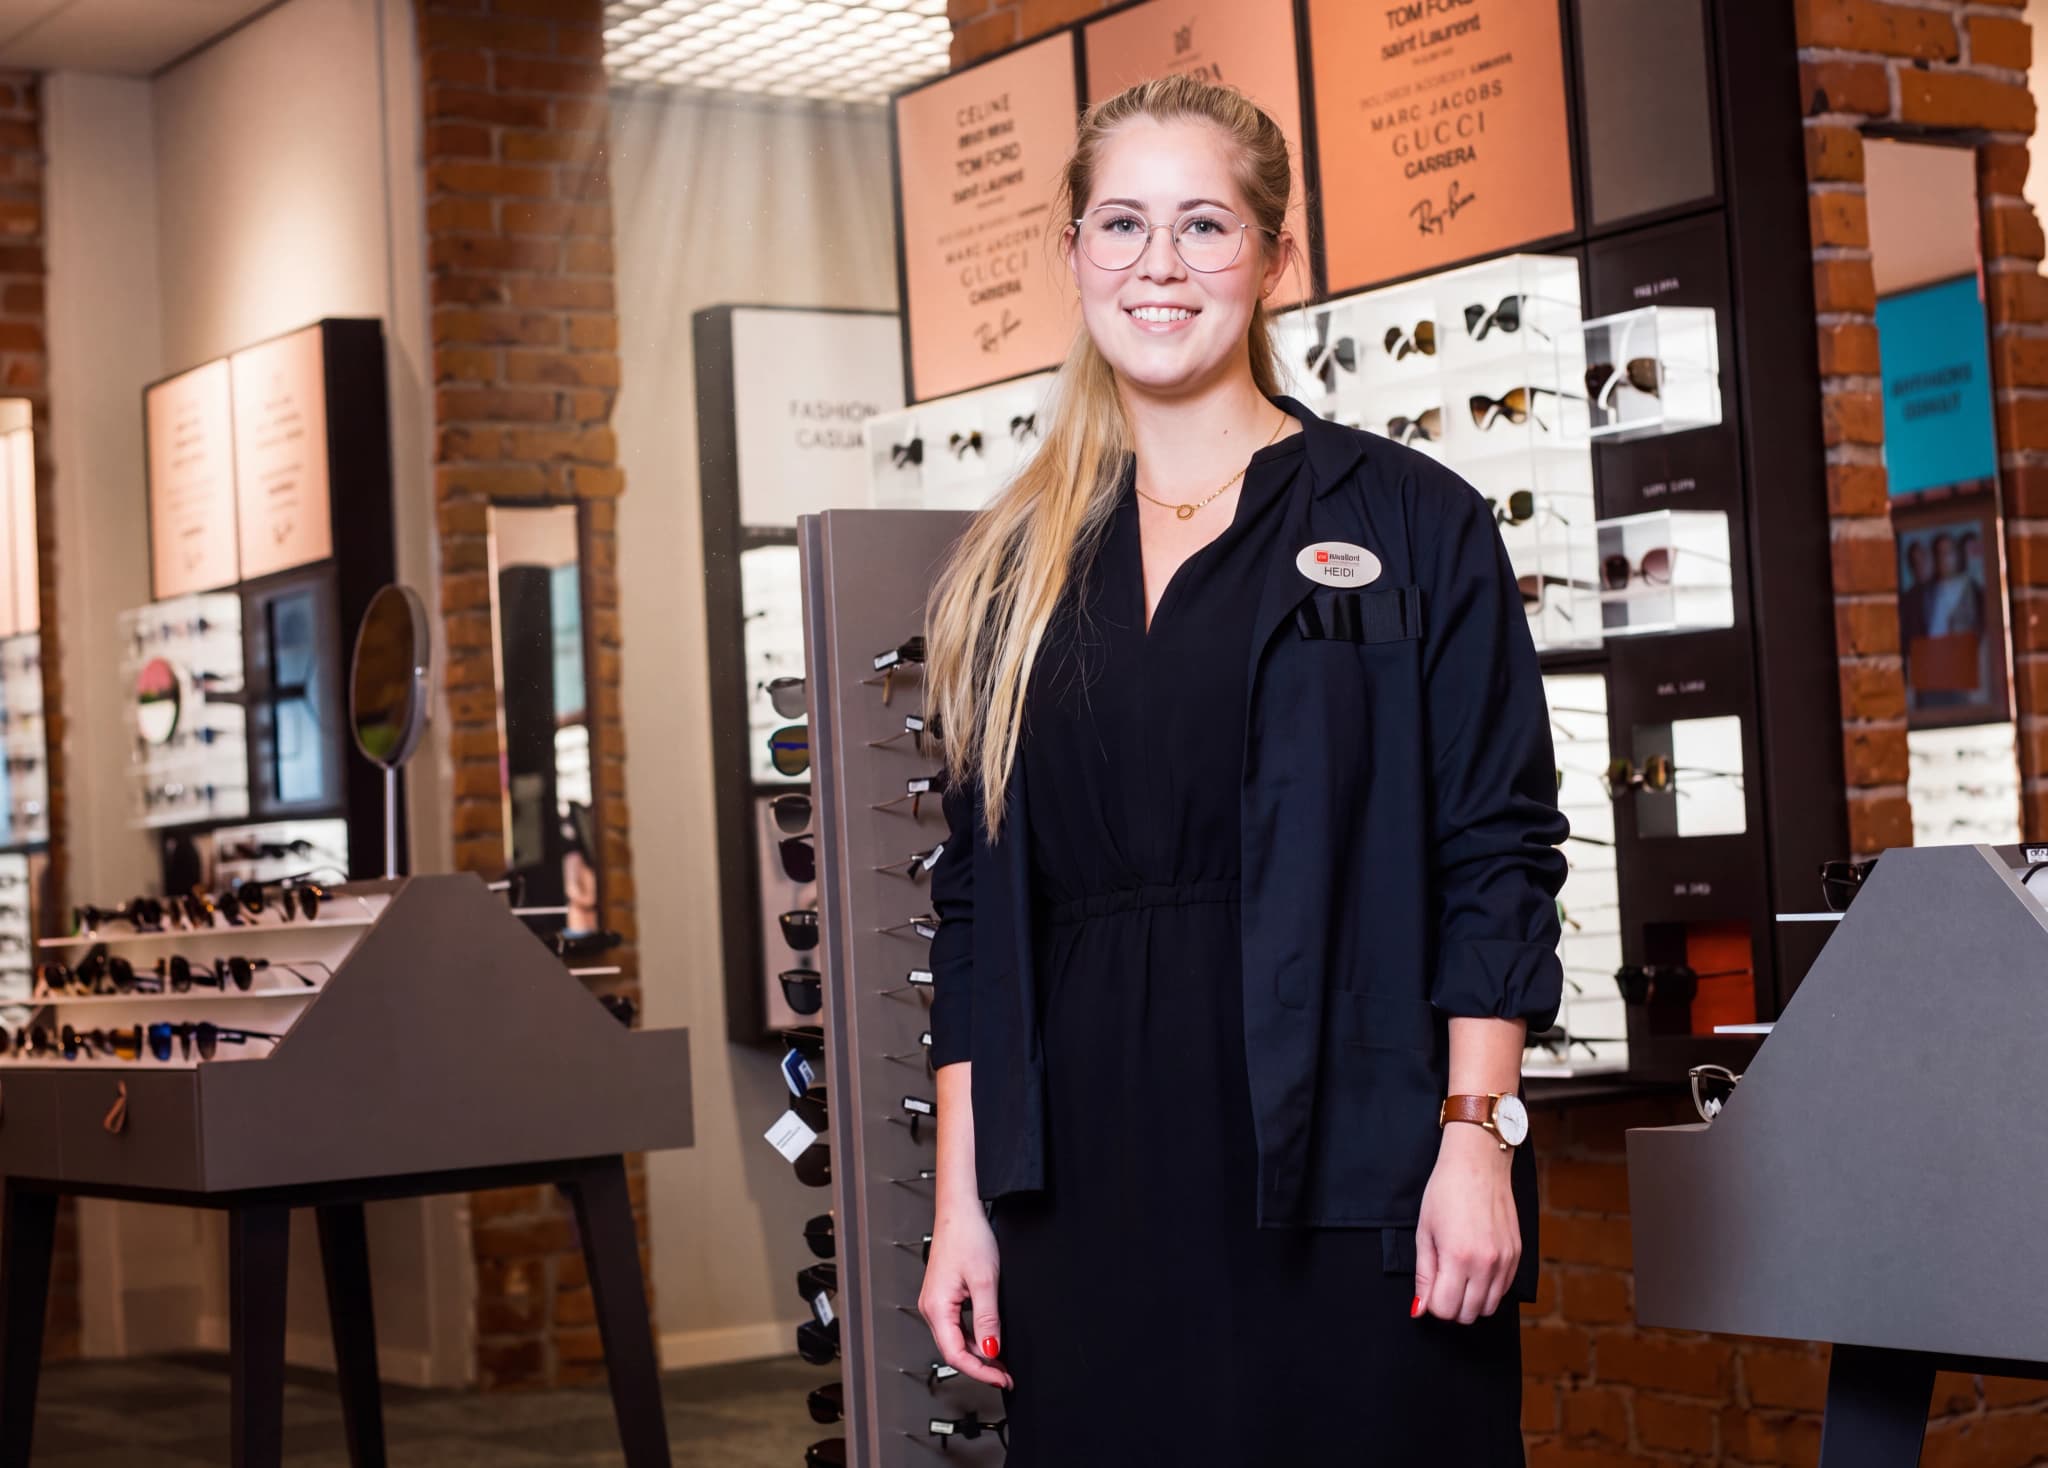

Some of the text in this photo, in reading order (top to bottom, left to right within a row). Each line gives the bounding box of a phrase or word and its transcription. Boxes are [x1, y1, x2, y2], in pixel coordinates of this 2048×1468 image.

[1386, 1, 1423, 30] TOM
[1371, 104, 1421, 132] MARC
[1429, 79, 1504, 116] JACOBS
[1392, 111, 1485, 157] GUCCI
[1404, 145, 1477, 179] CARRERA
[794, 428, 865, 450] CASUA
[1324, 566, 1354, 577] HEIDI
